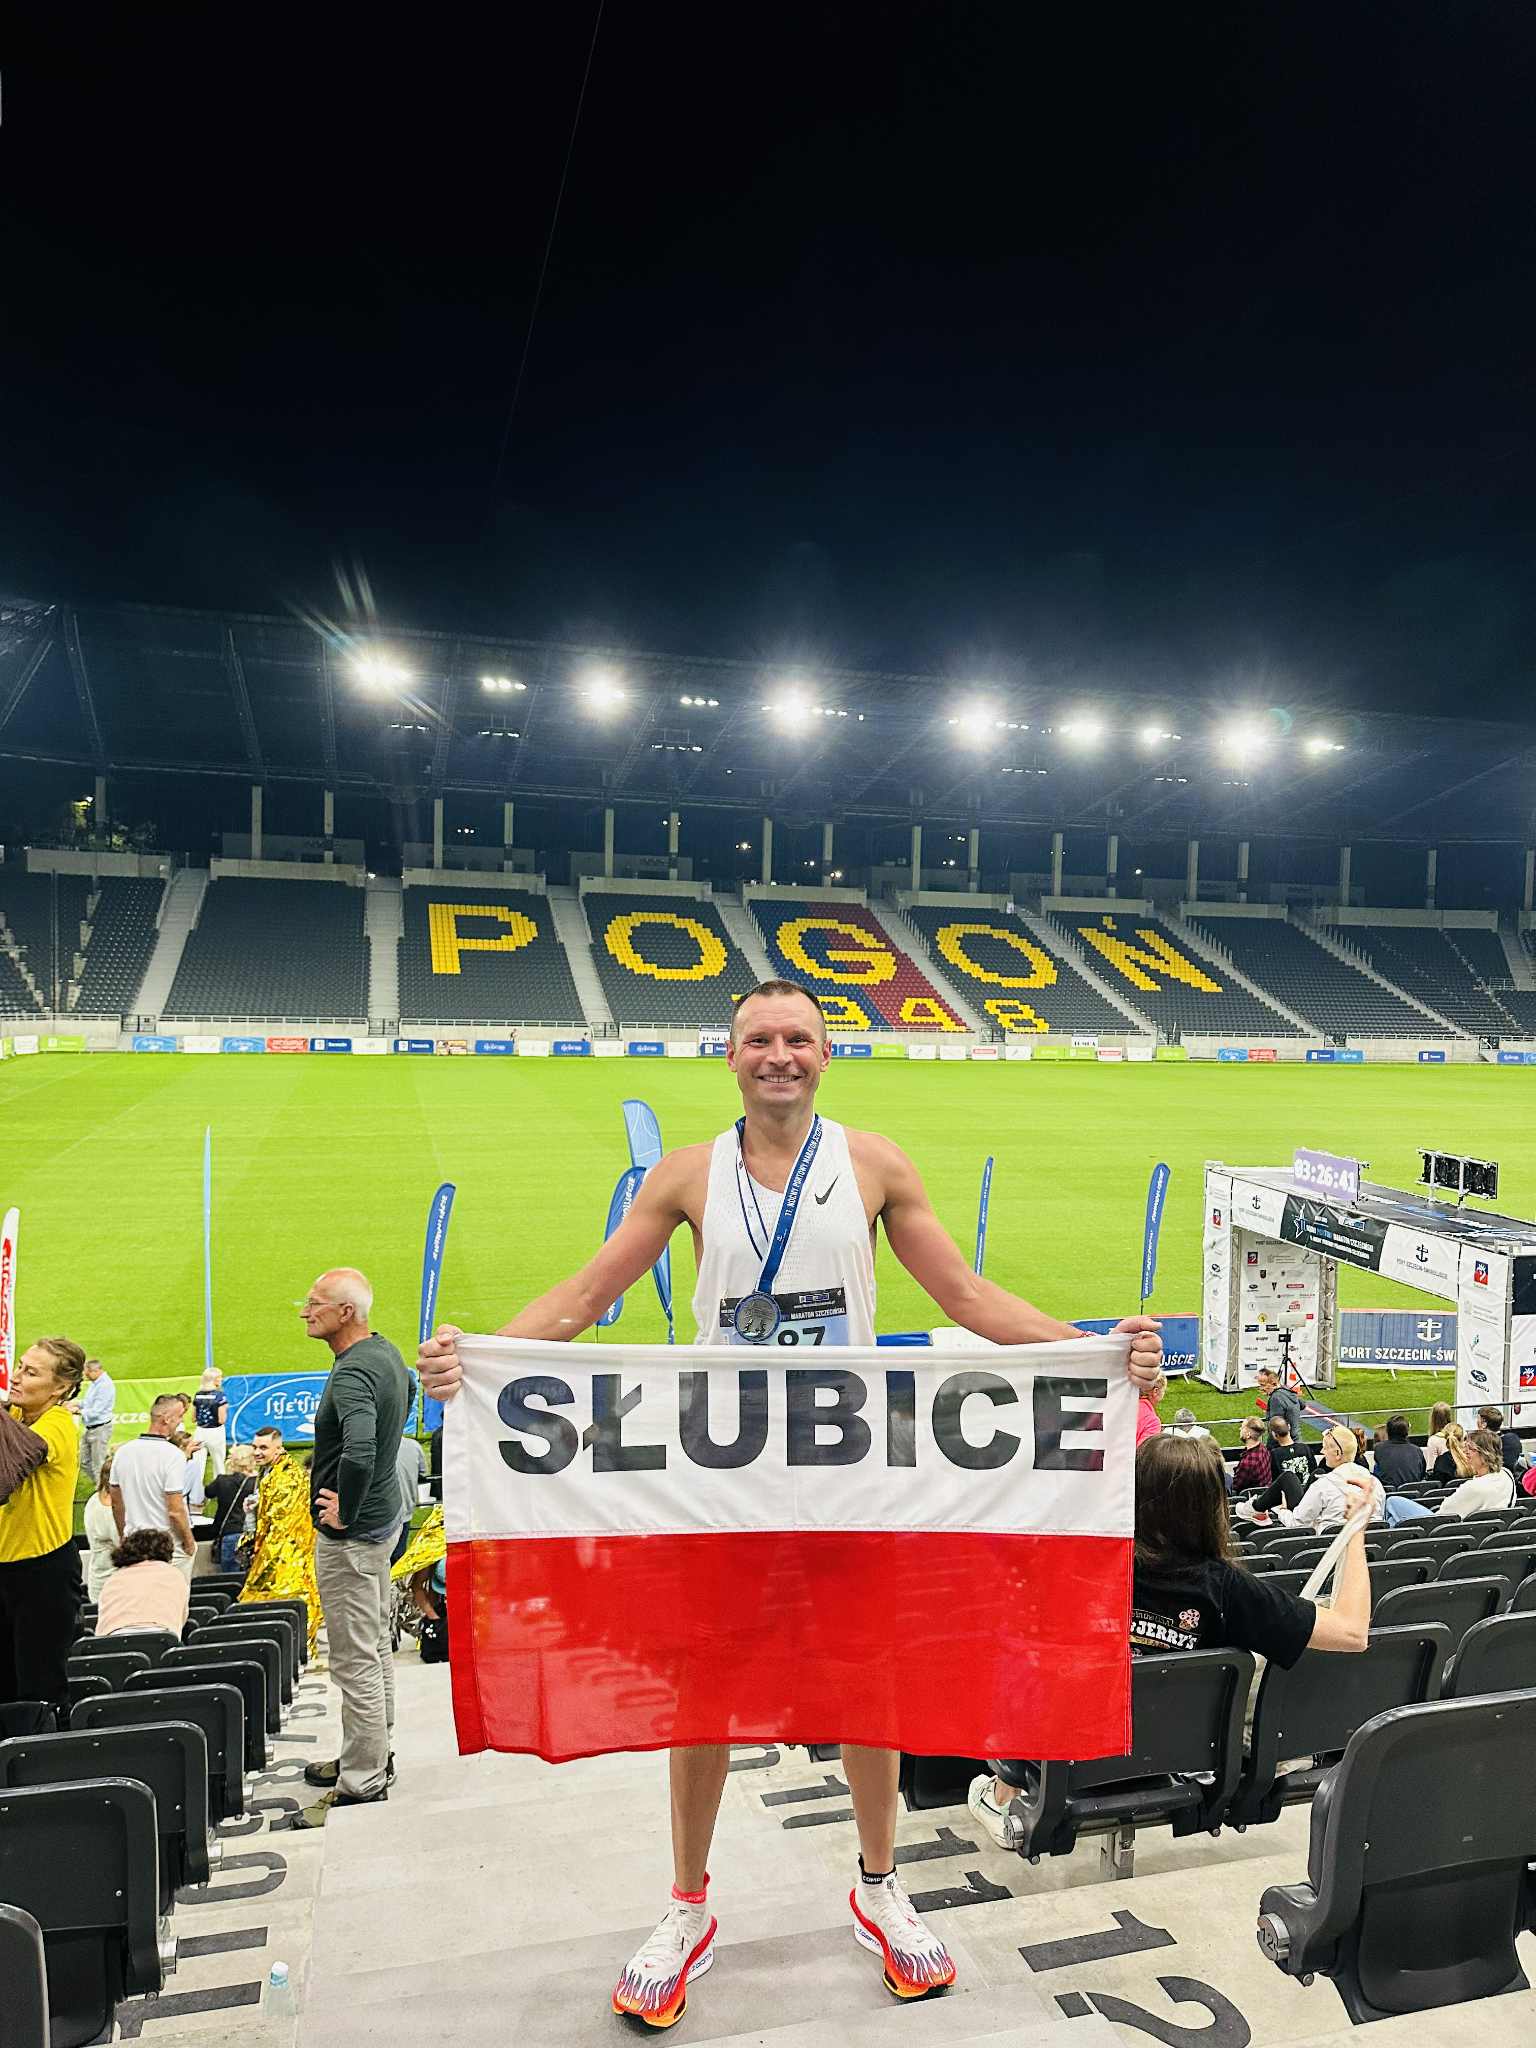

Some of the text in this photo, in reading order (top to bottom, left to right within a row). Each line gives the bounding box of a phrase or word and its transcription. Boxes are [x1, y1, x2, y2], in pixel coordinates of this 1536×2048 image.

[429, 903, 1223, 994] POGOŃ
[790, 1311, 815, 1321] MARATON
[1341, 1346, 1371, 1359] PORT
[497, 1370, 1108, 1474] SŁUBICE
[1136, 1620, 1198, 1650] JERRY'S
